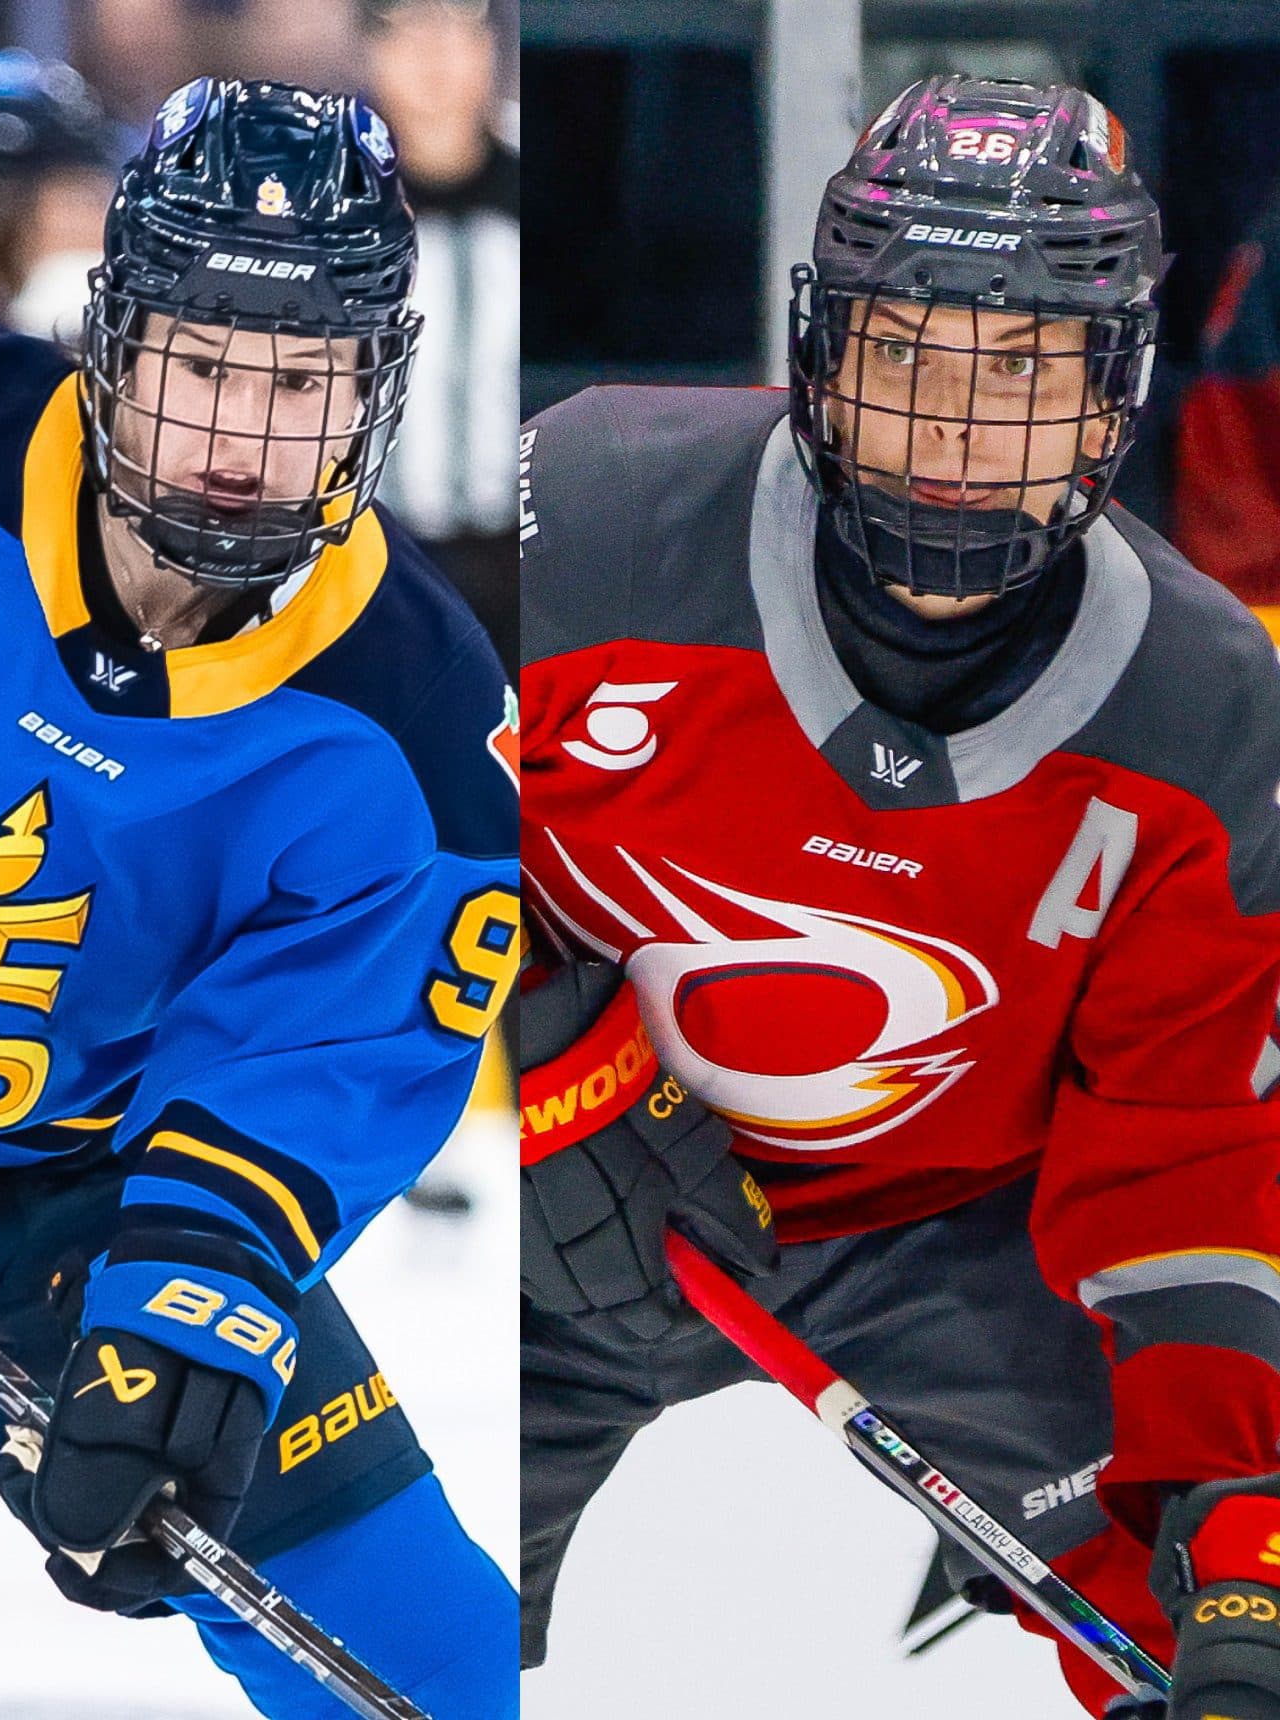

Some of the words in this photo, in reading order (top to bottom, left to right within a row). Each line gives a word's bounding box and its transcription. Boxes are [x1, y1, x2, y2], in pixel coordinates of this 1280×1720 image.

[949, 128, 1017, 163] 26
[1026, 795, 1140, 950] A
[423, 881, 520, 1041] 9
[185, 1526, 226, 1564] WATTS
